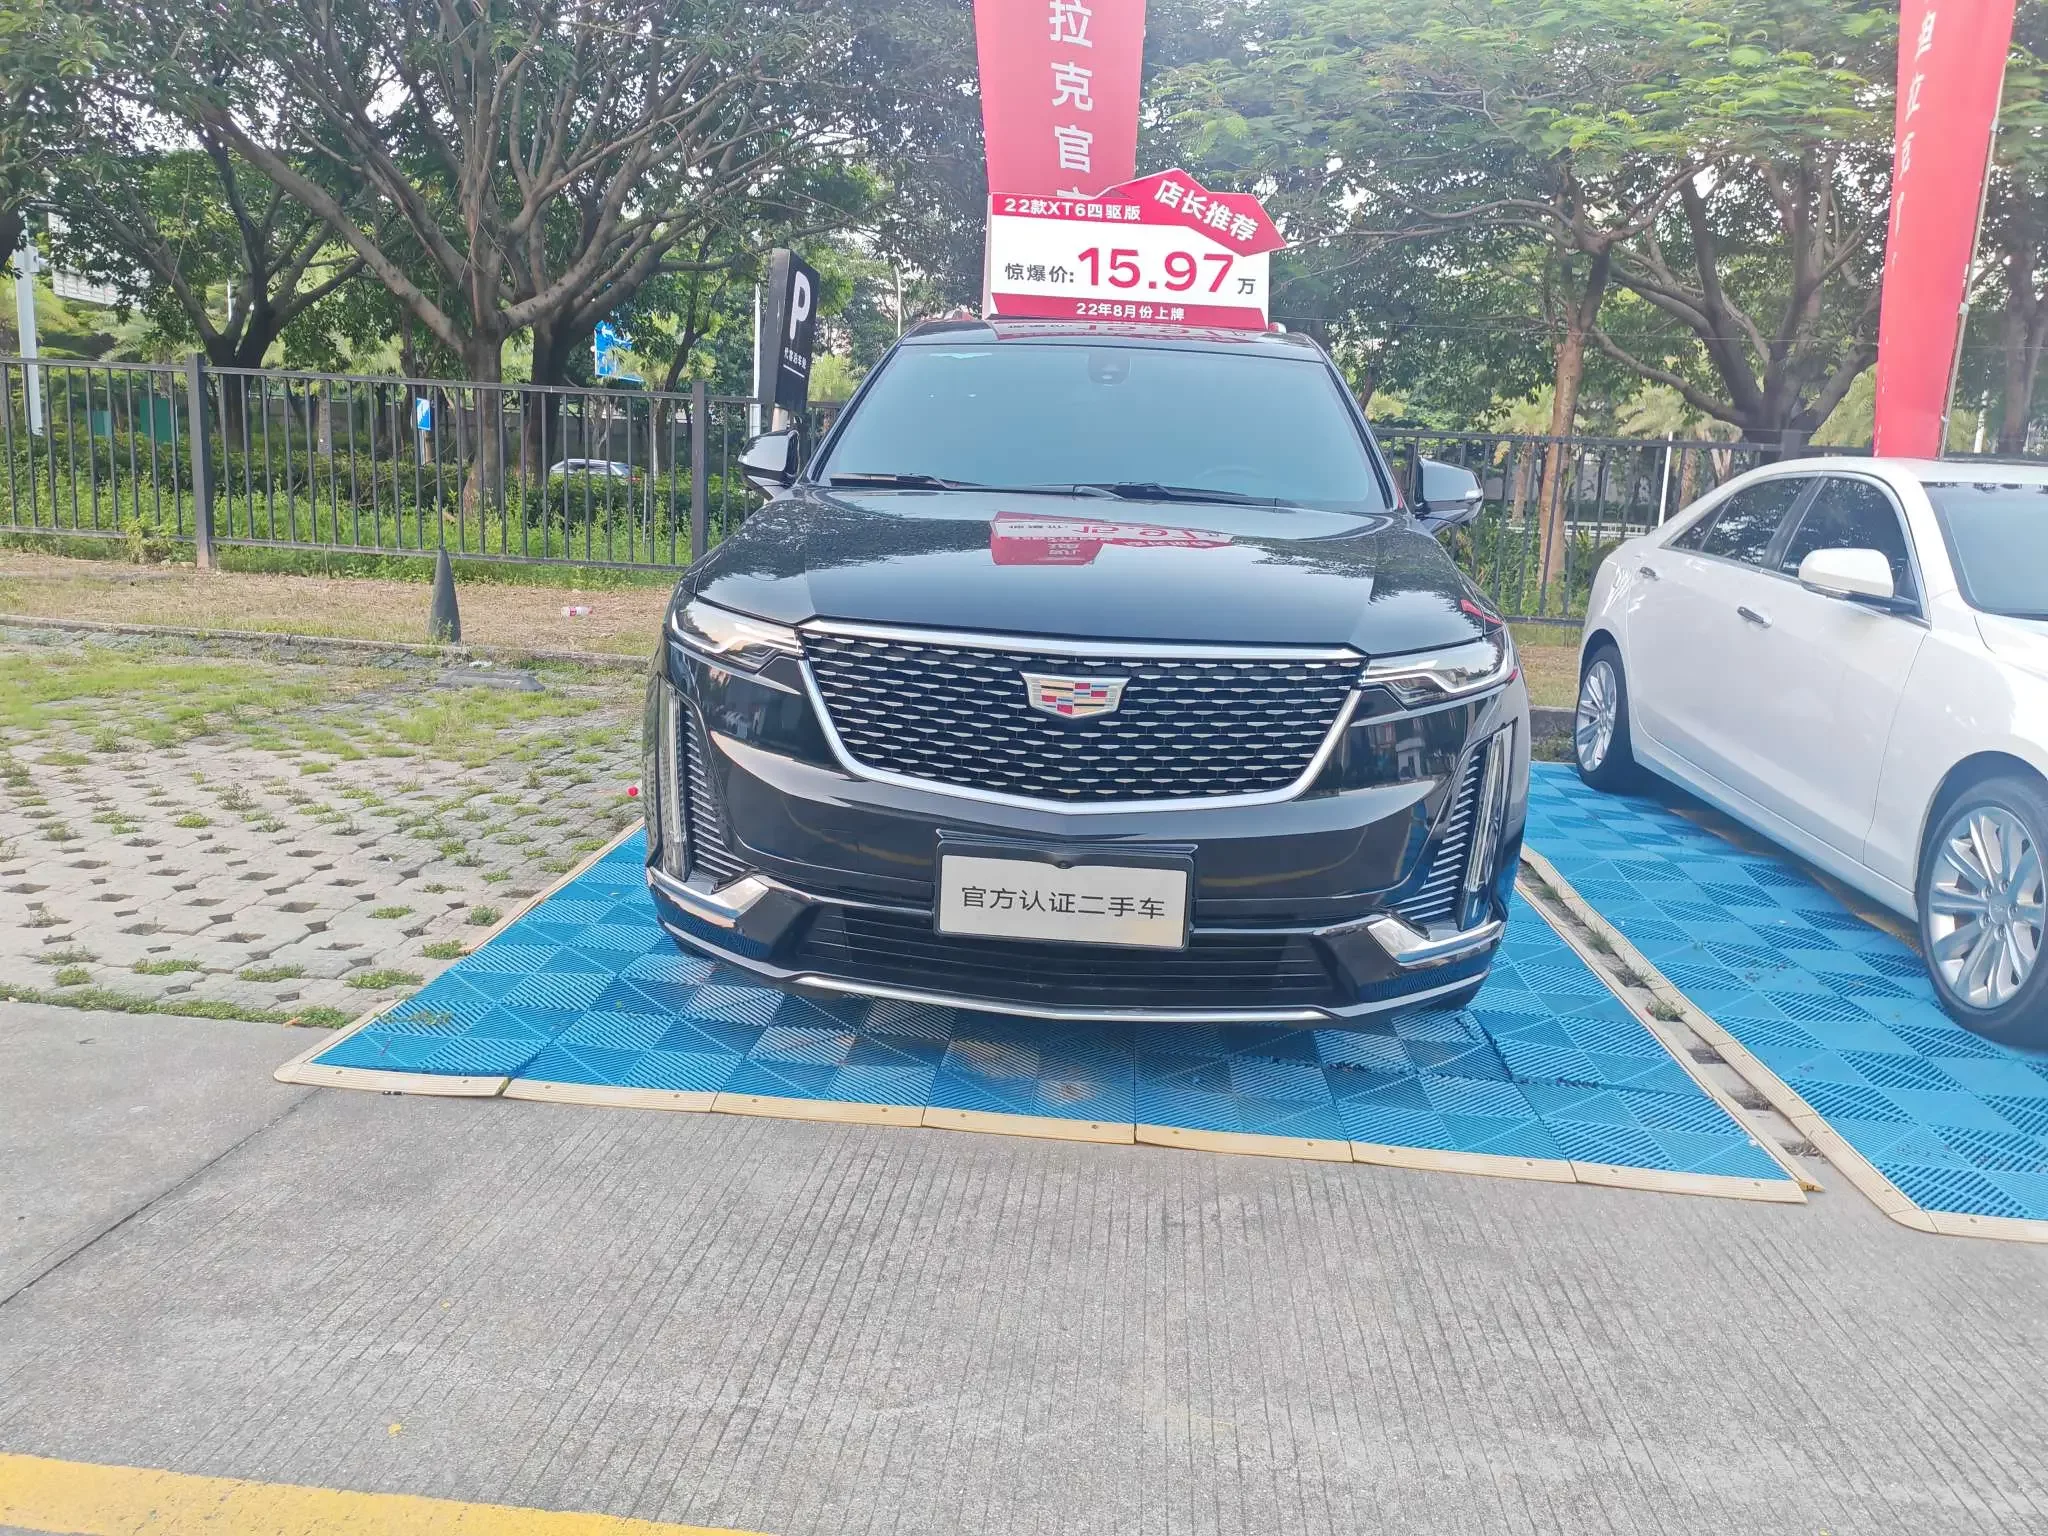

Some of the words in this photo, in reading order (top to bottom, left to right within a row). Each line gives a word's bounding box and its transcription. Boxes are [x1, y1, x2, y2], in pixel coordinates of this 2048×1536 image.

[1004, 198, 1141, 221] 22款XT6四驱版
[1154, 180, 1259, 242] 店长推荐
[1078, 247, 1234, 292] 15.97
[1237, 278, 1256, 295] 万
[789, 270, 811, 340] P
[1076, 302, 1185, 321] 22年8月份上牌
[961, 886, 1165, 919] 官方认证二手车
